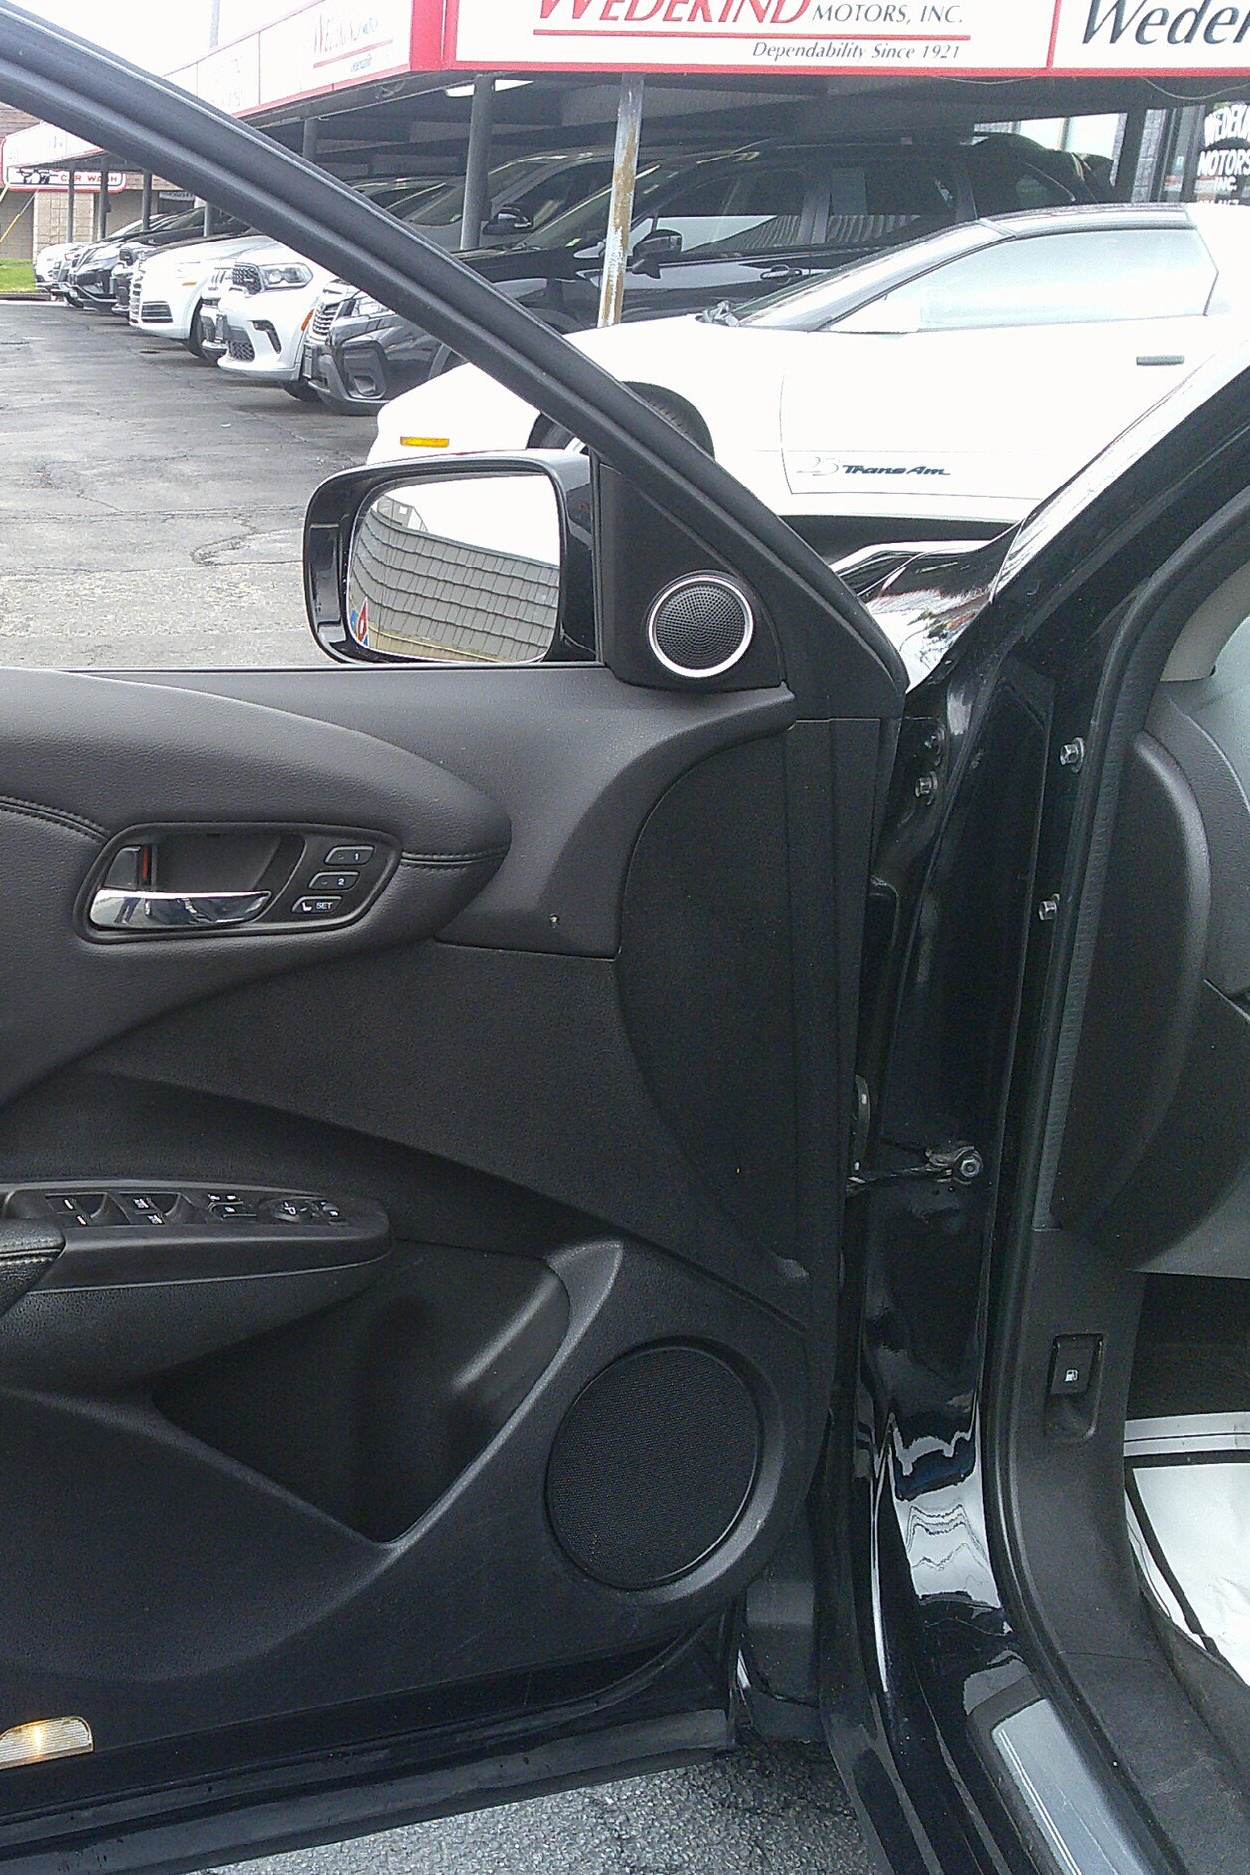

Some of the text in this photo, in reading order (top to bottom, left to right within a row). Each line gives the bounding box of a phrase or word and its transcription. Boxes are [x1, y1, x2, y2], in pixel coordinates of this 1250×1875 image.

[811, 3, 911, 25] MOTORS,
[919, 4, 963, 23] INC.
[752, 41, 960, 62] Dependability Since 1921
[60, 174, 118, 184] CR WAH
[842, 464, 907, 475] Trans
[906, 465, 951, 475] Am
[337, 877, 345, 886] 2
[315, 901, 333, 910] SET
